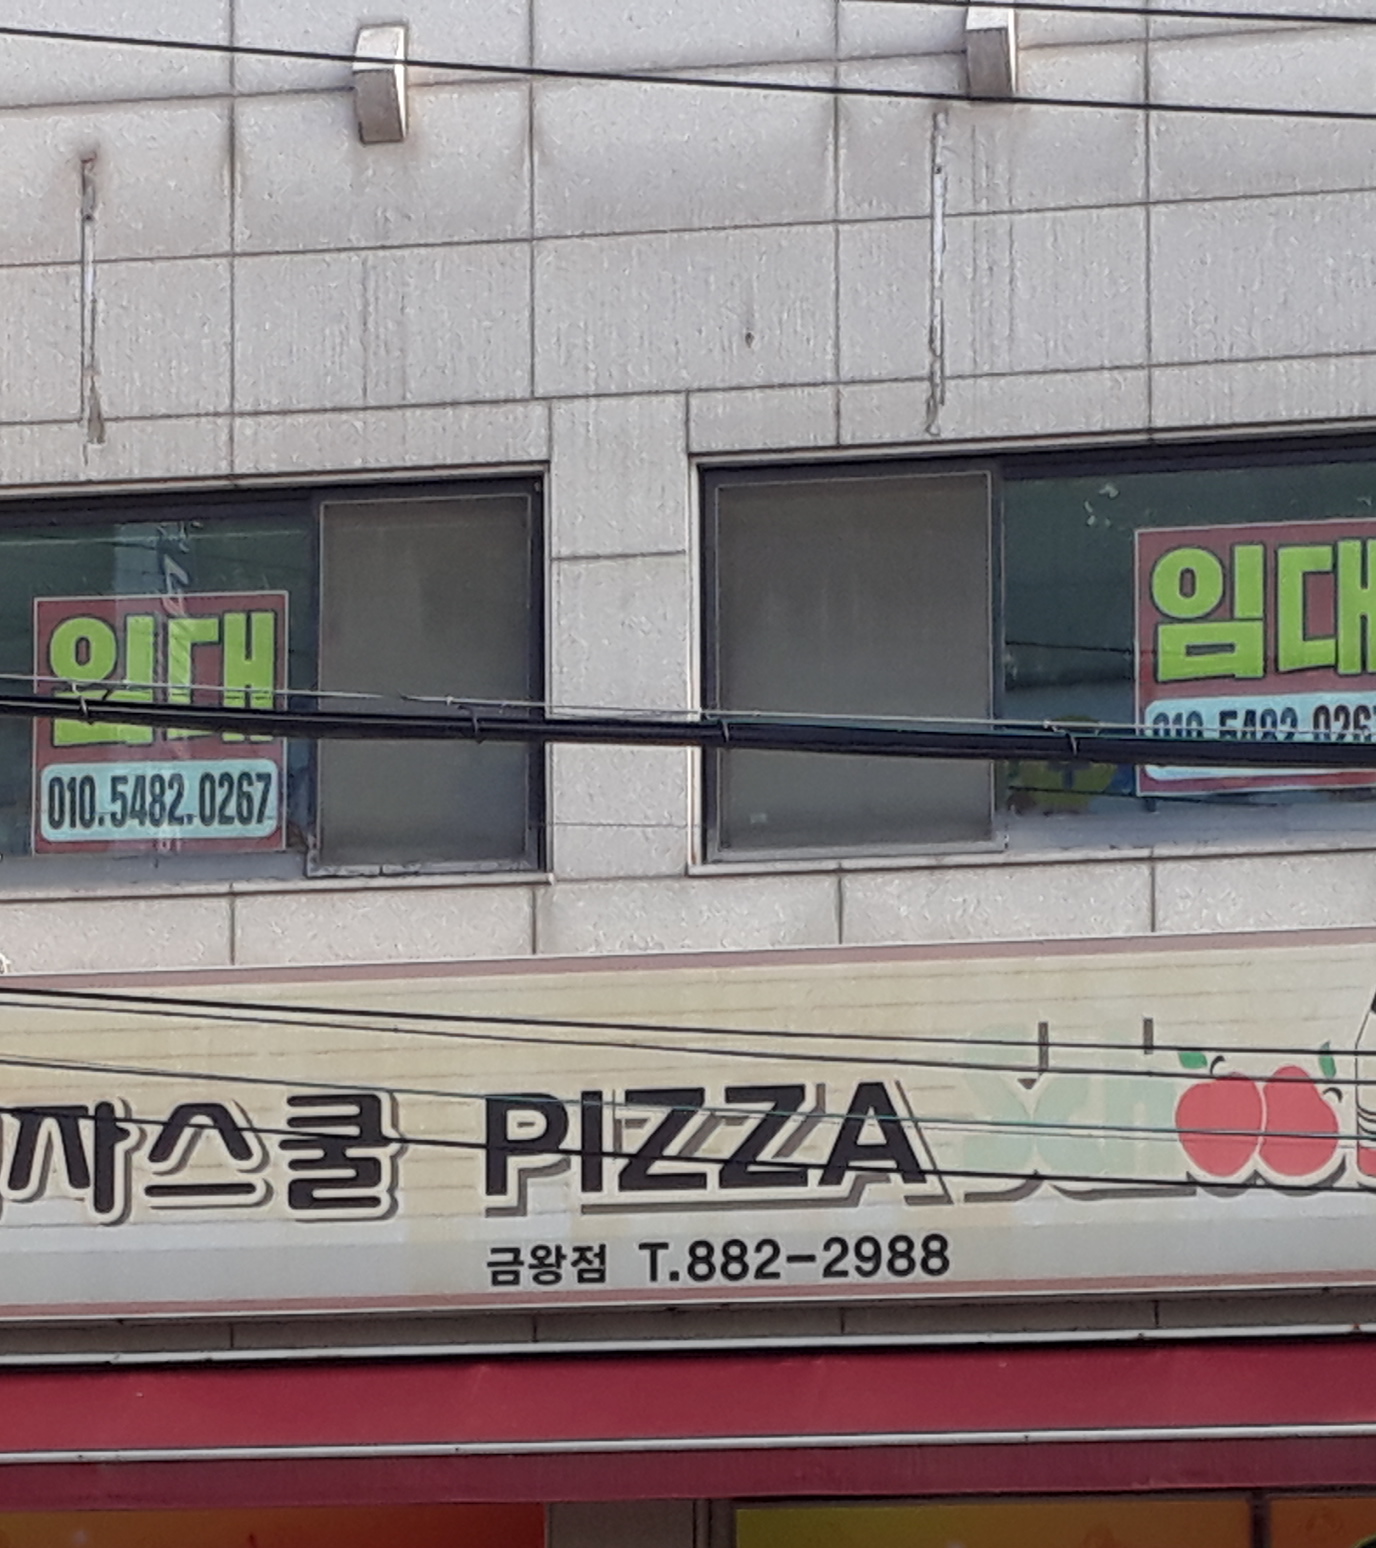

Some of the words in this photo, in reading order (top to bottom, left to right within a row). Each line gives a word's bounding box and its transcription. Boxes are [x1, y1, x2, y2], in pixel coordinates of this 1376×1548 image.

[48, 610, 277, 747] 임대
[46, 771, 273, 831] 010.5482.0267
[484, 1079, 930, 1198] PIZZA
[486, 1241, 608, 1285] 금왕점
[637, 1232, 951, 1284] T.882-2988
